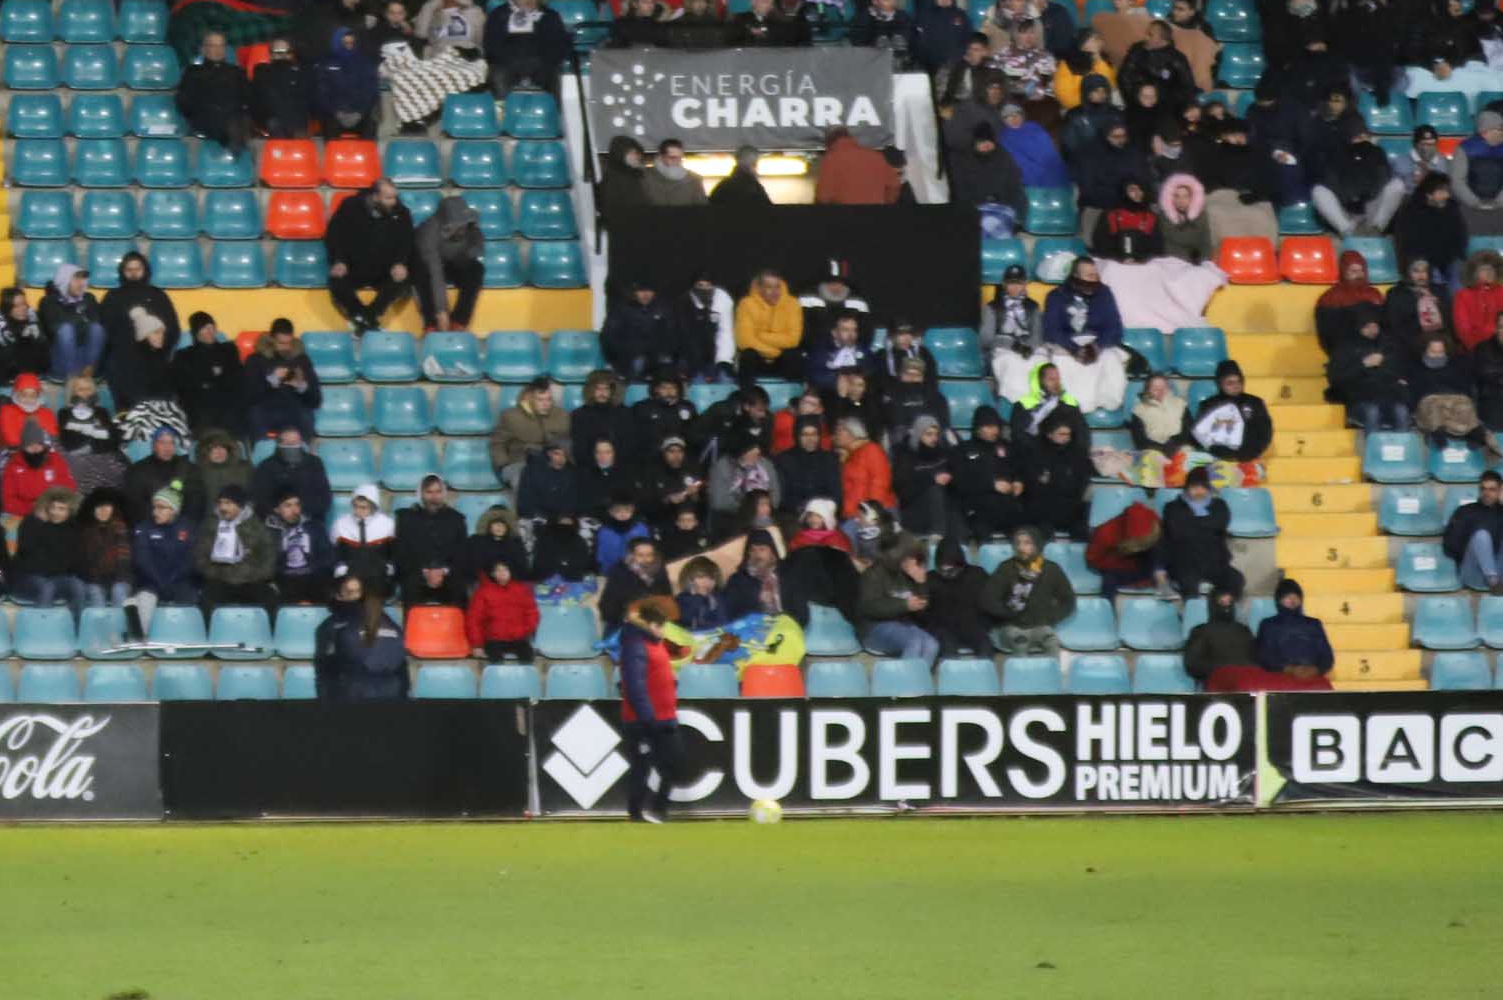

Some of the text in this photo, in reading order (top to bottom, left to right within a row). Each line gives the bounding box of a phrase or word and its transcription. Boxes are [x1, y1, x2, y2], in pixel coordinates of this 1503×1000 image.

[670, 69, 818, 96] ENERGÍA
[671, 95, 882, 129] CHARRA
[1076, 702, 1242, 762] HIELO
[667, 707, 1067, 802] CUBERS
[1075, 764, 1240, 801] PREMIUM
